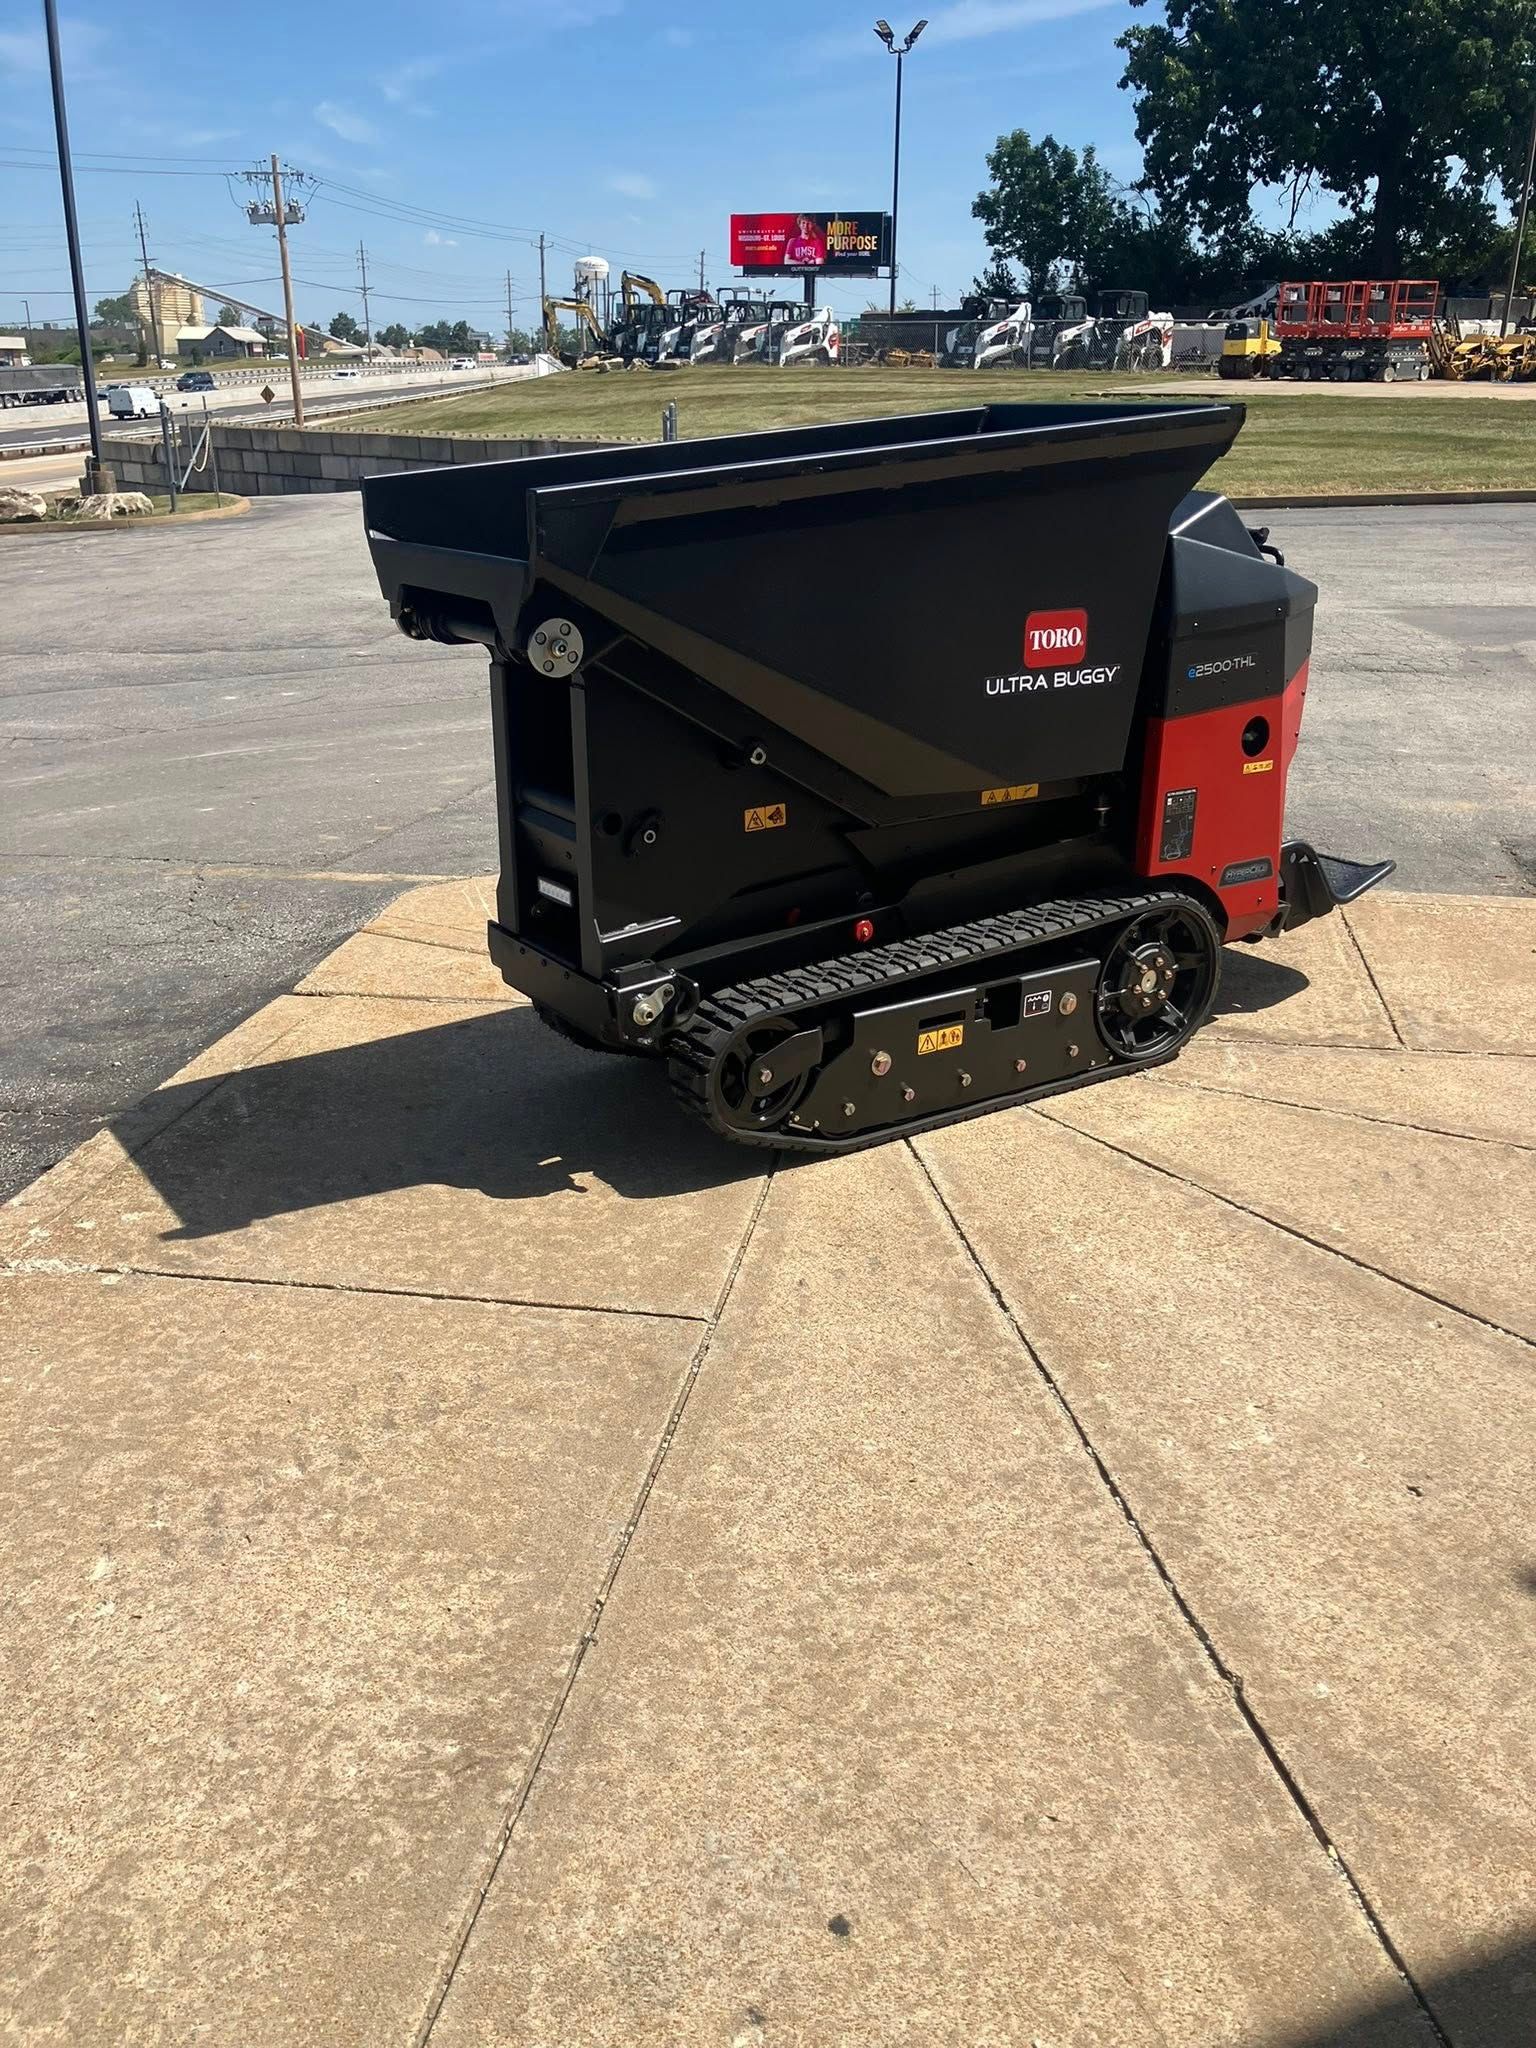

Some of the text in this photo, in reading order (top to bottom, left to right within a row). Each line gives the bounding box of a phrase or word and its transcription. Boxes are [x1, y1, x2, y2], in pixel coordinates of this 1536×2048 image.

[827, 221, 859, 235] MORE
[826, 235, 878, 250] PURPOSE
[795, 246, 816, 258] UMSL
[1029, 626, 1083, 650] TORO
[986, 667, 1119, 695] ULTRA BUGGY
